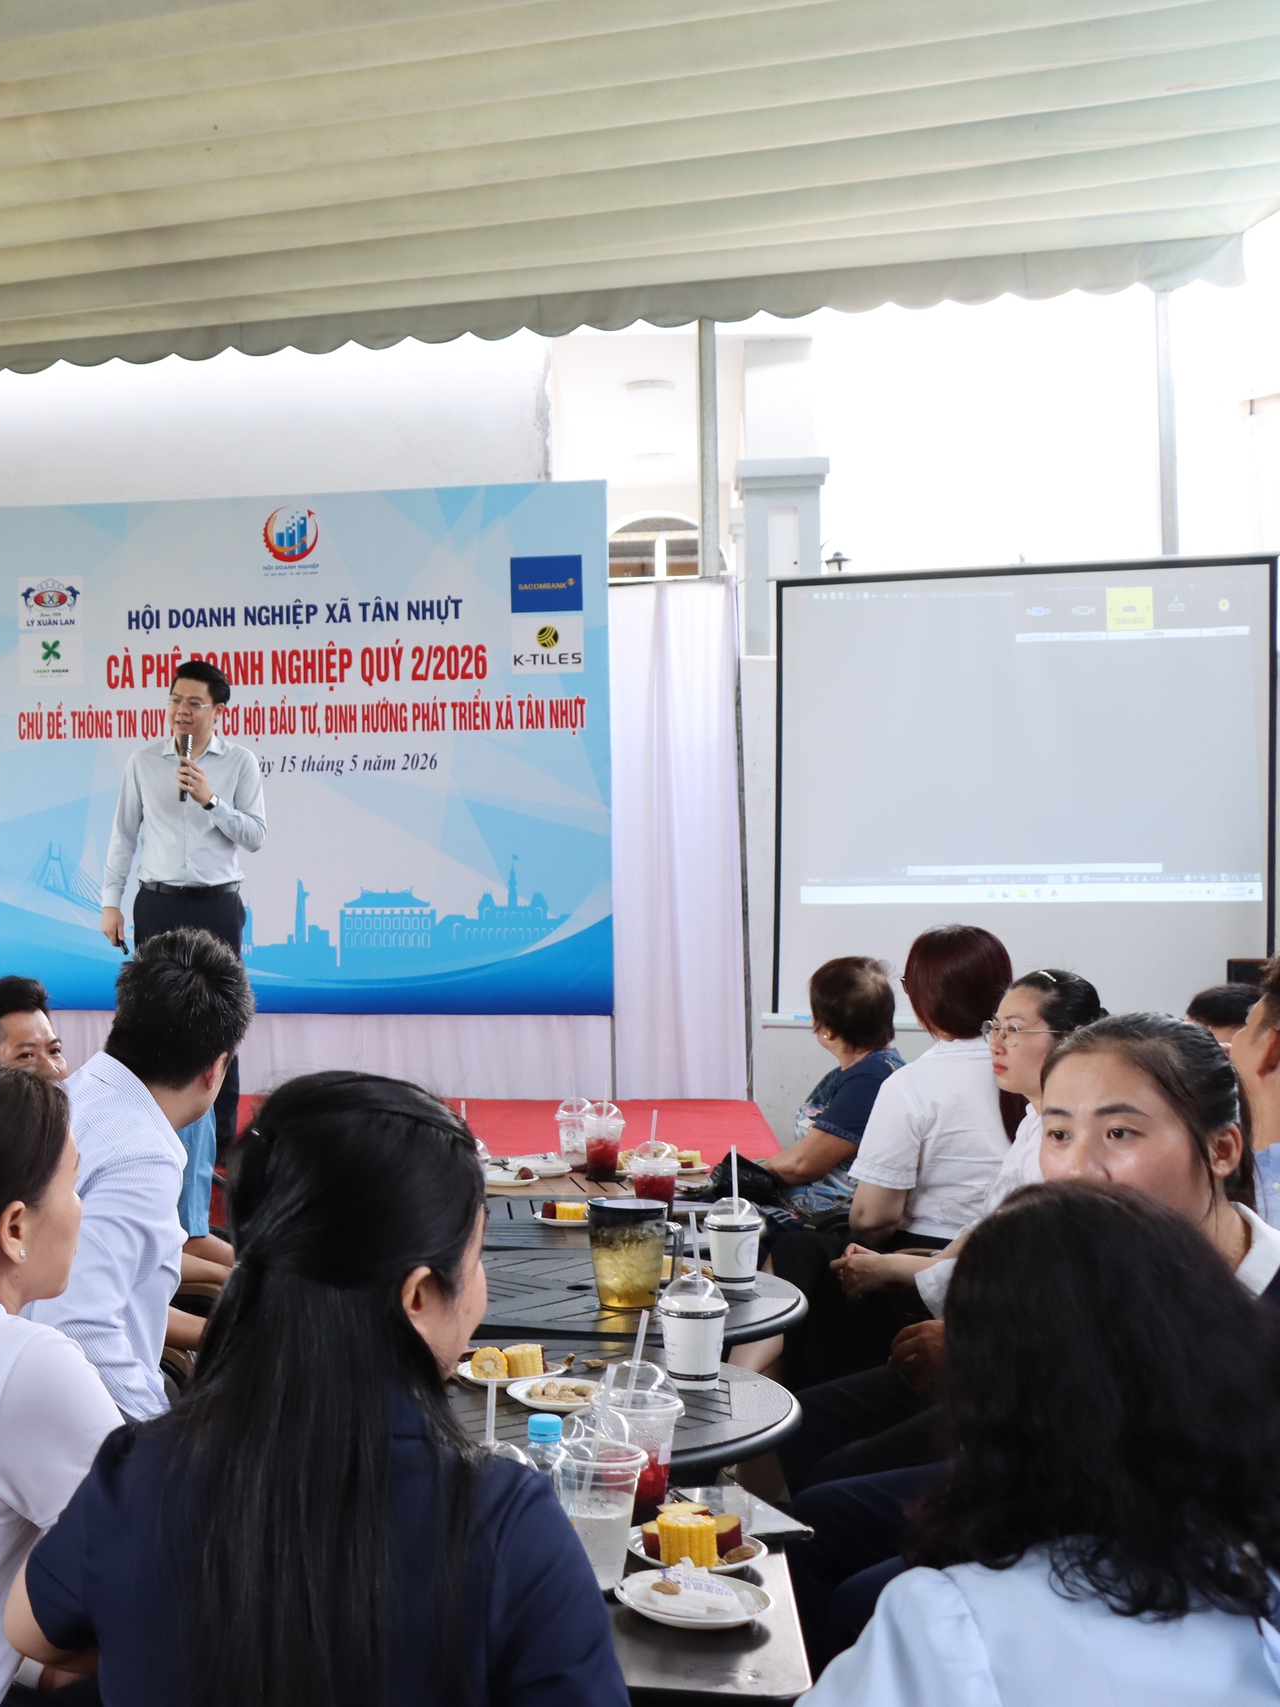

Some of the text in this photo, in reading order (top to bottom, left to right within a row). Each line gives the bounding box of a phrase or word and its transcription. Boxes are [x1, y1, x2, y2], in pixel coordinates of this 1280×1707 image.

[518, 582, 567, 590] SACOMBANK
[127, 595, 463, 635] HỘI DOANH NGHIỆP XÃ TÂN NHỰT
[1115, 617, 1146, 625] 1280x800
[106, 646, 135, 690] CÀ
[271, 640, 353, 692] NGHIỆP
[360, 638, 404, 687] QUÝ
[411, 644, 488, 681] 2/2026
[513, 652, 582, 666] K-TILES
[18, 701, 44, 741] CHỦ
[46, 701, 67, 740] ĐỀ:
[70, 704, 113, 739] THÔNG
[116, 708, 137, 738] TIN
[141, 708, 166, 741] QUY
[222, 704, 240, 736] CƠ
[243, 700, 266, 742] HỘI
[269, 695, 297, 735] ĐẦU
[300, 702, 321, 738] TƯ,
[324, 704, 358, 741] ĐỊNH
[361, 697, 408, 733] HƯỚNG
[412, 696, 447, 732] PHÁT
[451, 688, 491, 731] TRIỂN
[494, 694, 514, 730] XÃ
[517, 693, 545, 730] TÂN
[548, 695, 586, 736] NHỰT
[258, 752, 439, 778] ày 15 tháng 5 năm 2026
